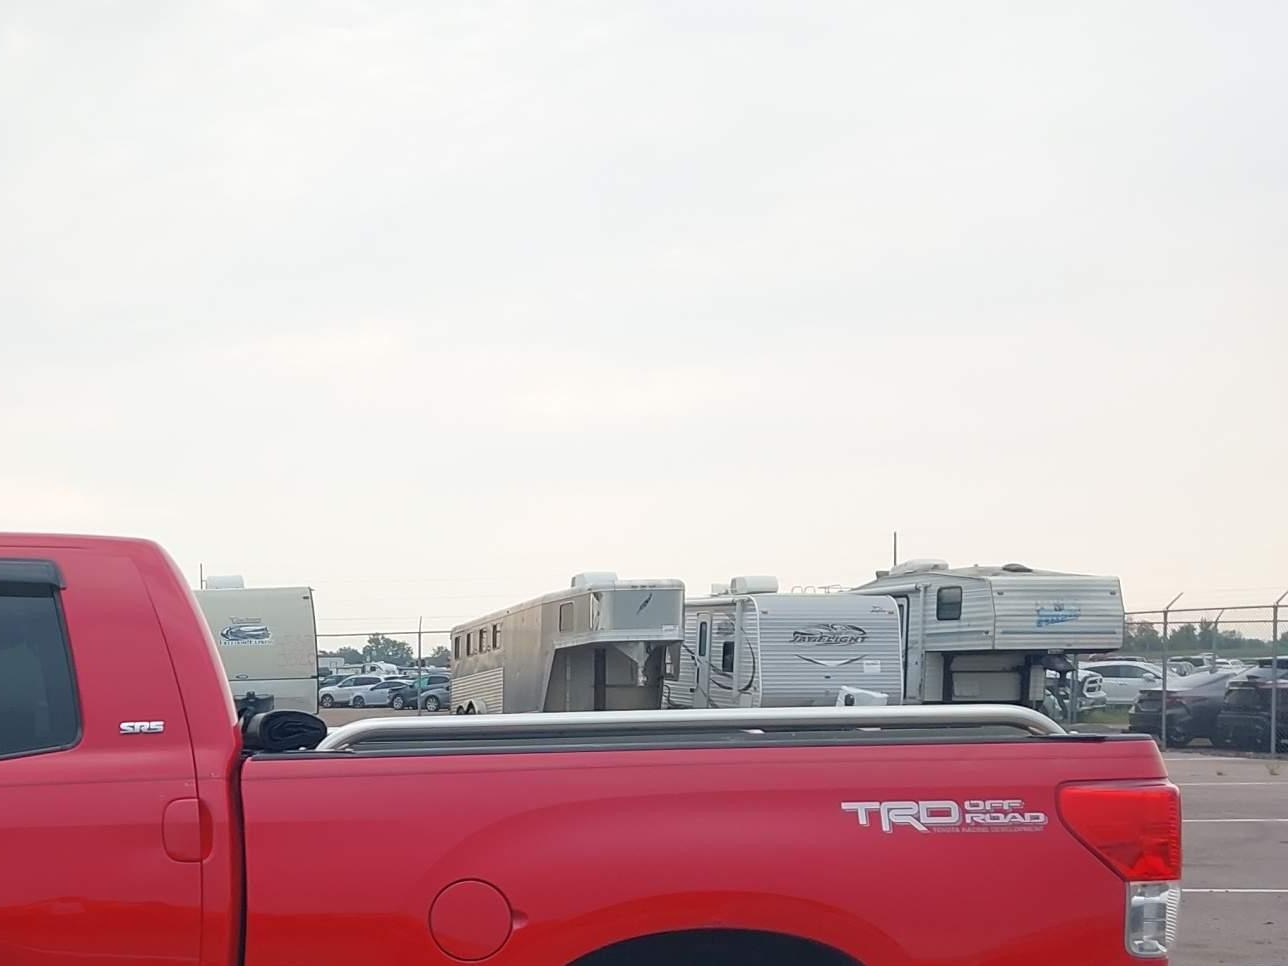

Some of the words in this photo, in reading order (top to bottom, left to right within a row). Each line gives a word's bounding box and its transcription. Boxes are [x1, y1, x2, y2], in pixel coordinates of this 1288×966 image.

[964, 800, 1024, 811] OFF
[840, 800, 961, 833] TRD
[965, 813, 1047, 825] ROAD
